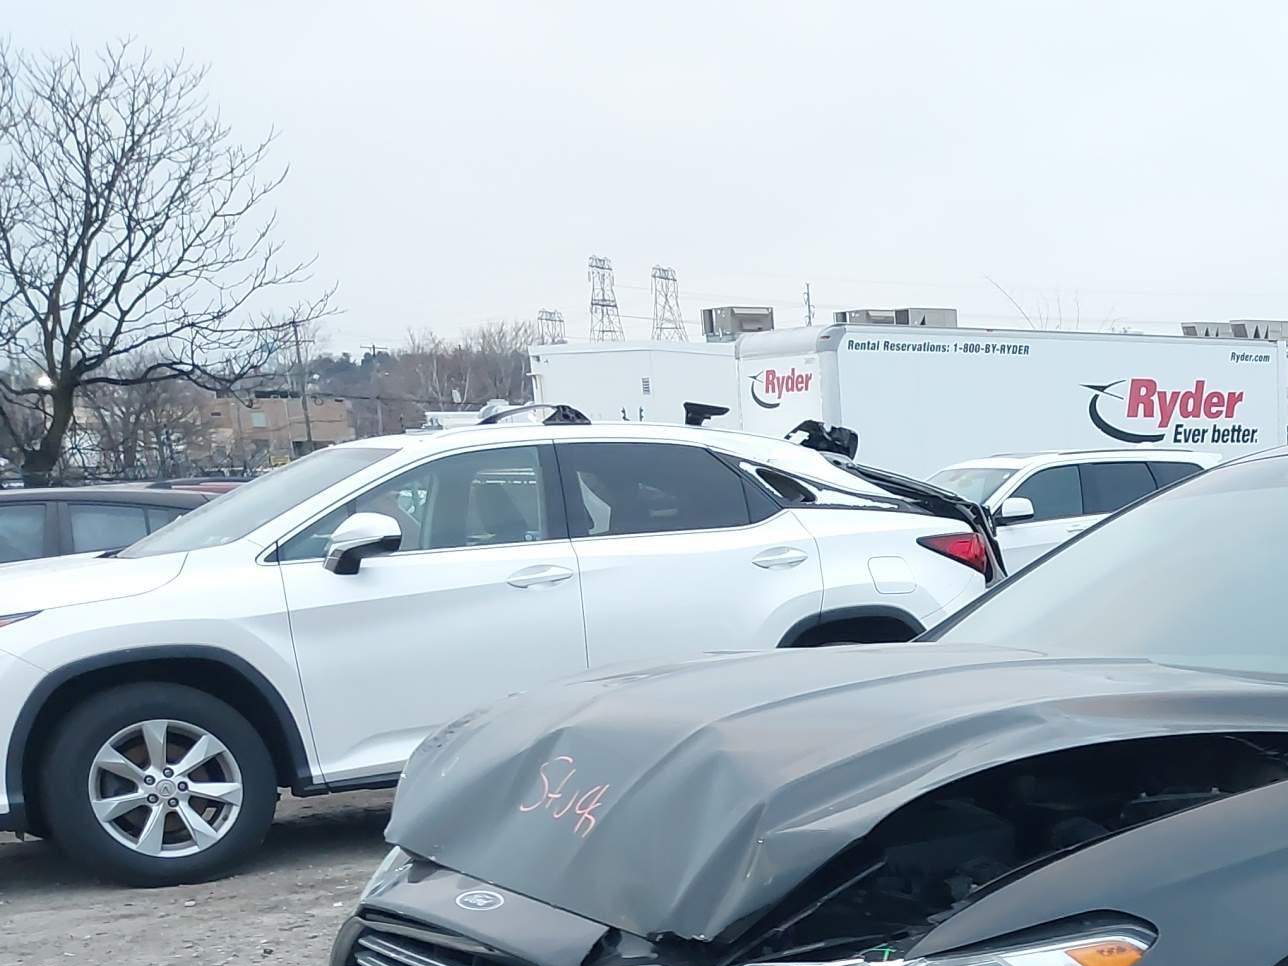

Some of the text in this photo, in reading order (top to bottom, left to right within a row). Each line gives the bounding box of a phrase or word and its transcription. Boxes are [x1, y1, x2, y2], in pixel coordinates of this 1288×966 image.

[848, 339, 1030, 355] Rental Reservations: 1-800-BY-RYDER
[1230, 351, 1271, 363] Ryder.com
[765, 367, 812, 399] Ryder
[1126, 378, 1244, 428] Ryder
[1173, 423, 1258, 444] Ever better.
